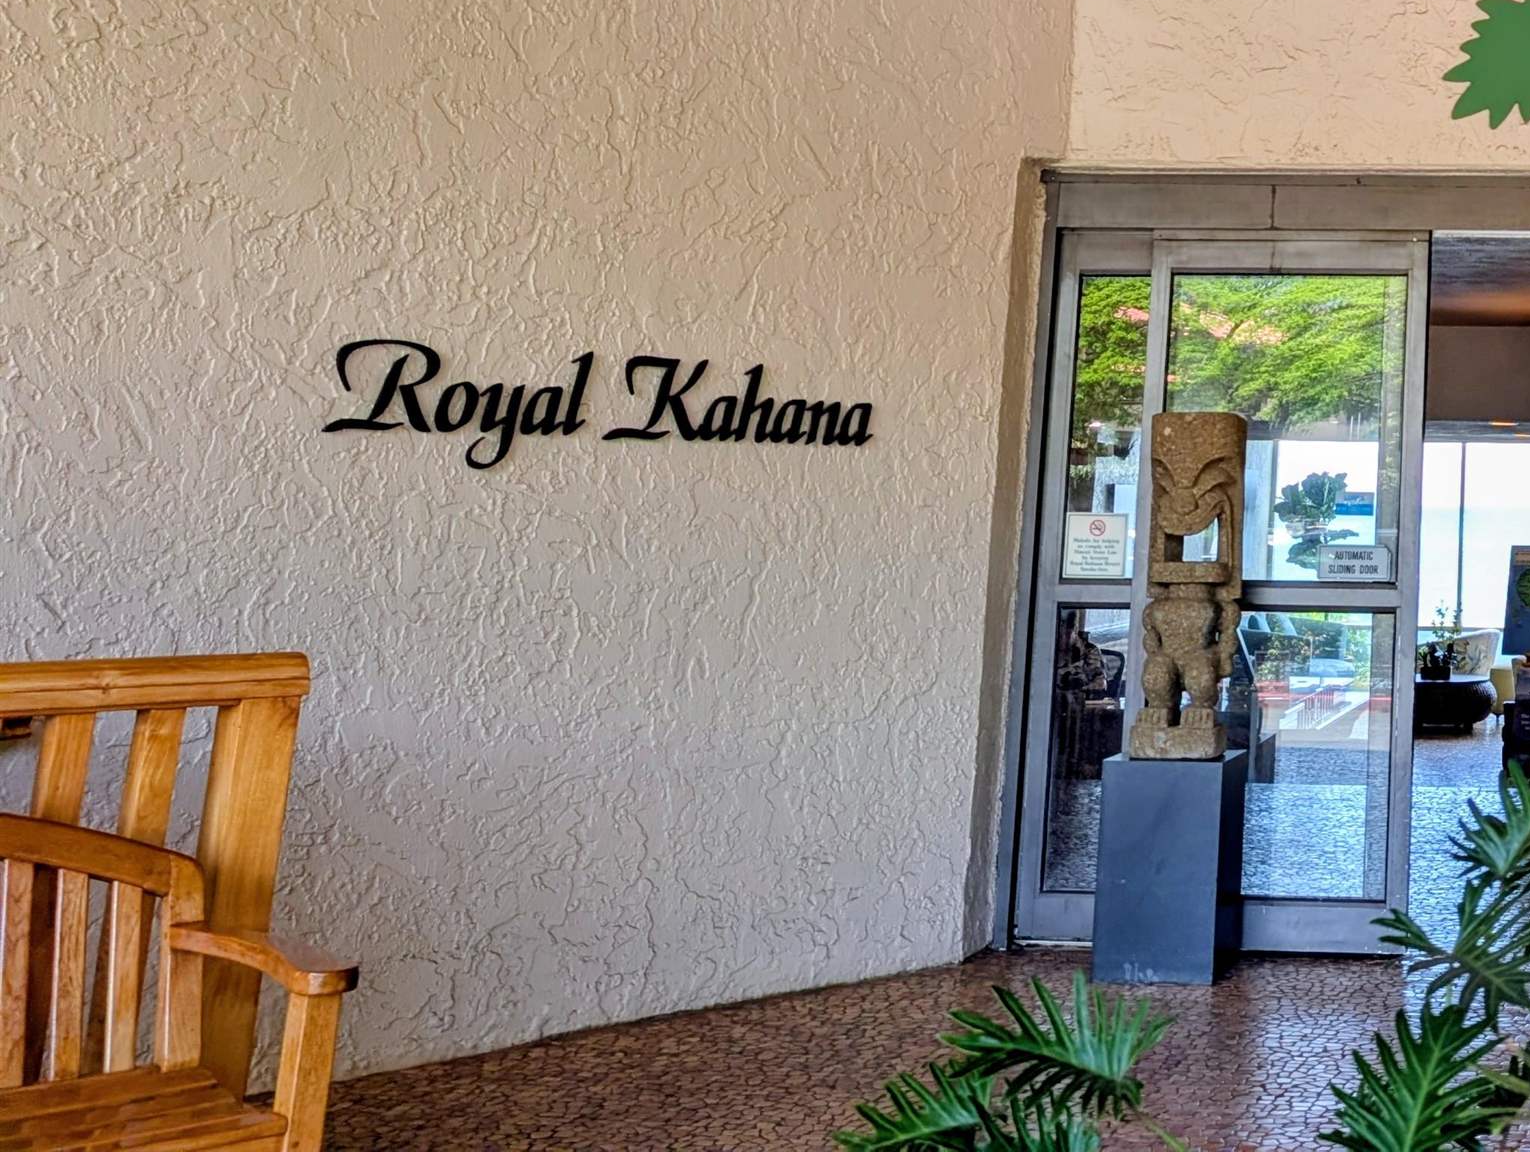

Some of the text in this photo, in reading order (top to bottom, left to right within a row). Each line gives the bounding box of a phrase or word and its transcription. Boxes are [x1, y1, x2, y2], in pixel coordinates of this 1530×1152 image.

[322, 338, 874, 470] Royal Kahana
[1335, 550, 1374, 561] AUTOMATIC
[1328, 564, 1379, 575] SLIDING DOOR
